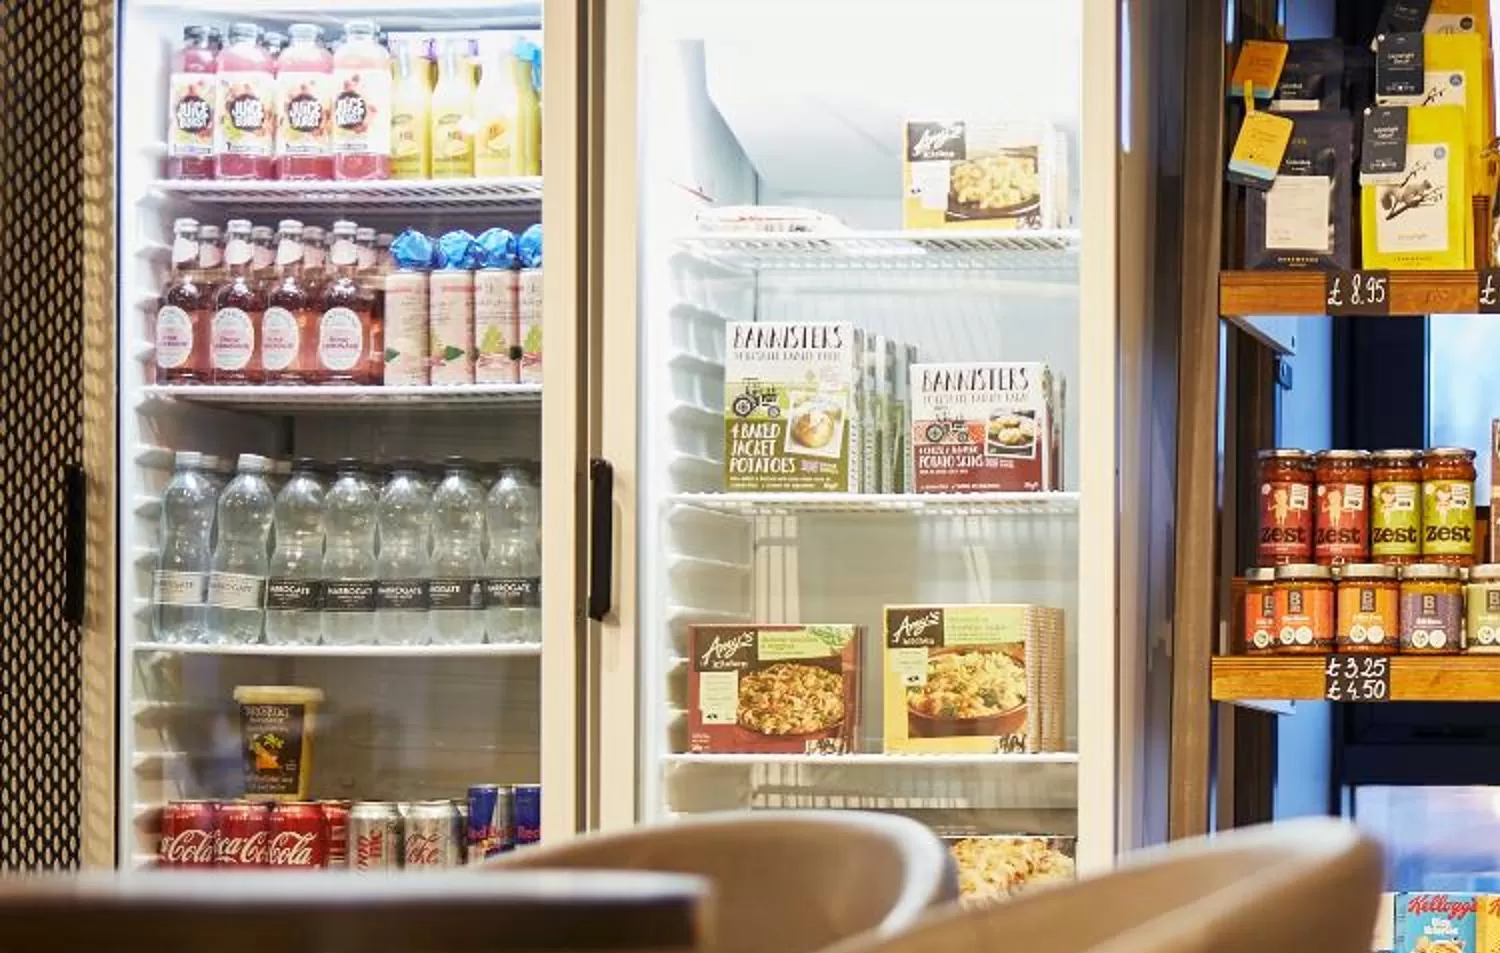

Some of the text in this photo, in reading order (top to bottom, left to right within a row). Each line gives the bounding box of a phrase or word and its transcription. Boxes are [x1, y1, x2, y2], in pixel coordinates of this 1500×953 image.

[1327, 273, 1388, 305] £8.95
[733, 325, 843, 349] BANNISTERS
[921, 367, 1030, 392] BANNISTERS
[741, 422, 781, 439] BAKED
[731, 440, 777, 457] JACKET
[729, 457, 796, 473] POTATOES
[1261, 525, 1306, 544] zest
[1315, 525, 1361, 544] zest
[1372, 525, 1417, 544] zest
[1425, 523, 1472, 544] zest
[892, 611, 940, 644] Amy's
[702, 631, 756, 666] Amy's
[1326, 657, 1387, 679] £3.25
[1327, 679, 1386, 700] £4.50
